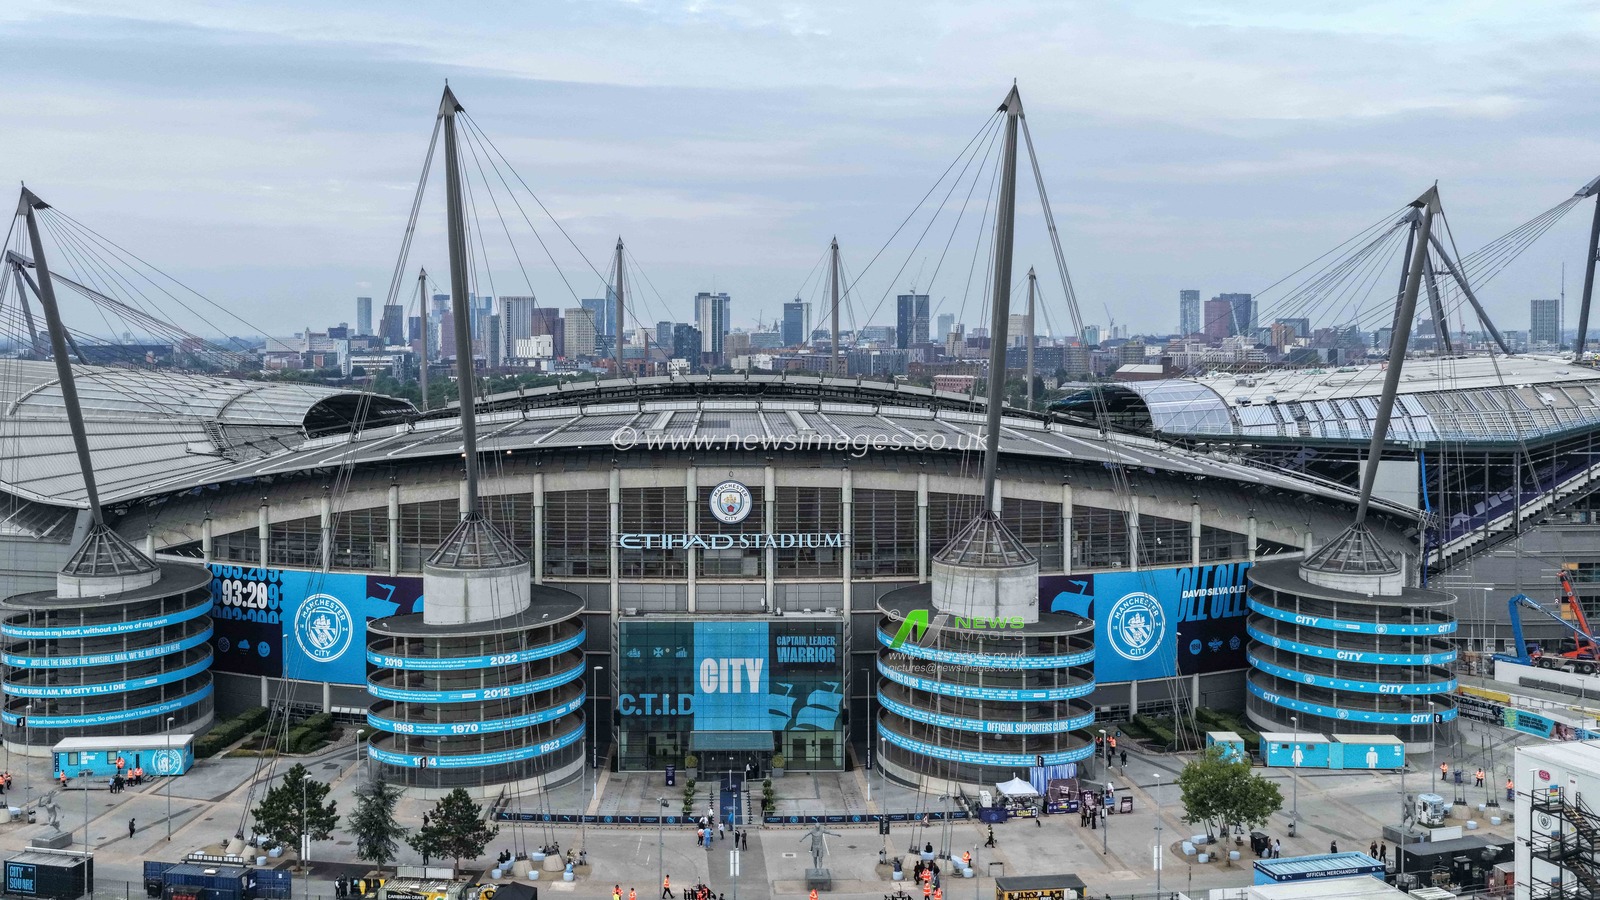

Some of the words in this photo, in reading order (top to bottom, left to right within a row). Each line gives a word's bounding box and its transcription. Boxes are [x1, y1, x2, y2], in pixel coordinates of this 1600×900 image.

[714, 484, 748, 498] MANCHESTER
[619, 533, 734, 550] ETIHAD
[739, 533, 843, 548] STADIUM
[222, 579, 268, 610] 93:20
[1182, 589, 1207, 599] DAVID
[1207, 586, 1228, 597] SILVA
[301, 599, 346, 621] MANCHESTER
[1114, 598, 1159, 619] MANCHESTER
[1295, 615, 1319, 626] CITY
[83, 625, 111, 634] without
[1438, 623, 1452, 633] CITY
[314, 649, 331, 657] CITY
[776, 646, 836, 663] WARRIOR
[1337, 650, 1363, 661] CITY
[60, 658, 72, 666] FANS
[79, 657, 88, 665] THE
[384, 657, 403, 668] 2019
[490, 654, 518, 665] 2022
[700, 658, 763, 693] CITY
[92, 685, 108, 693] TILL
[483, 687, 511, 699] 2012
[1379, 684, 1404, 694] CITY
[1263, 691, 1280, 704] CITY
[619, 693, 694, 716] C.T.I.D
[1411, 714, 1431, 723] CITY
[392, 722, 414, 733] 1968
[451, 723, 478, 734] 1970
[987, 722, 1014, 733] OFFICIAL
[1015, 722, 1052, 733] SUPPORTERS
[1053, 721, 1069, 731] CLUBS
[540, 739, 560, 753] 1923
[10, 866, 23, 878] CITY
[1326, 868, 1359, 876] MERCHANDISE
[10, 877, 33, 891] SQUARE
